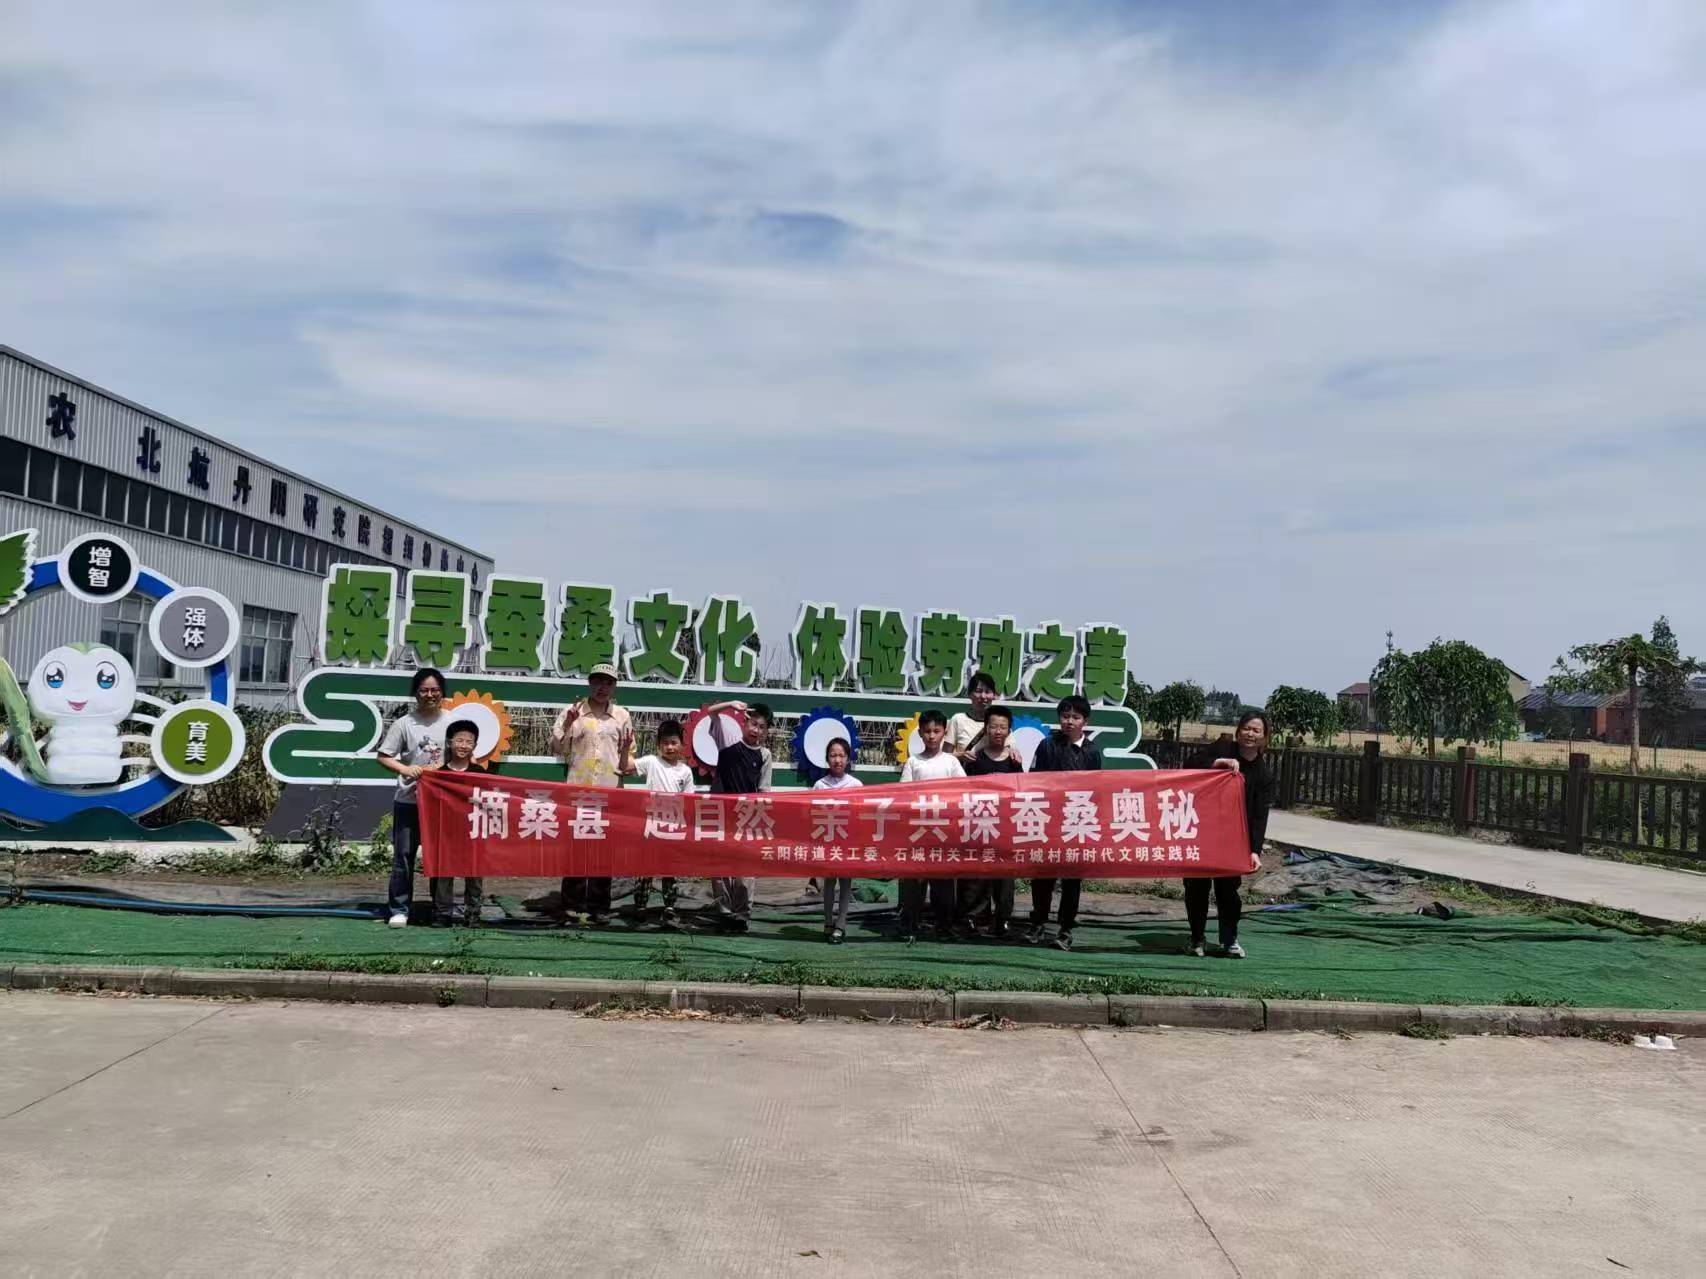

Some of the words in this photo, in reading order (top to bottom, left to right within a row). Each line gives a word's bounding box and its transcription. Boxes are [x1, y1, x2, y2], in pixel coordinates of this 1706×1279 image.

[88, 546, 112, 588] 增智
[183, 607, 207, 650] 强体
[325, 566, 758, 684] 探寻蚕桑文化
[797, 604, 1127, 702] 体验劳动之美
[185, 721, 209, 763] 育美
[468, 787, 610, 840] 摘桑葚
[810, 788, 1200, 844] 亲子共探蚕桑奥秘
